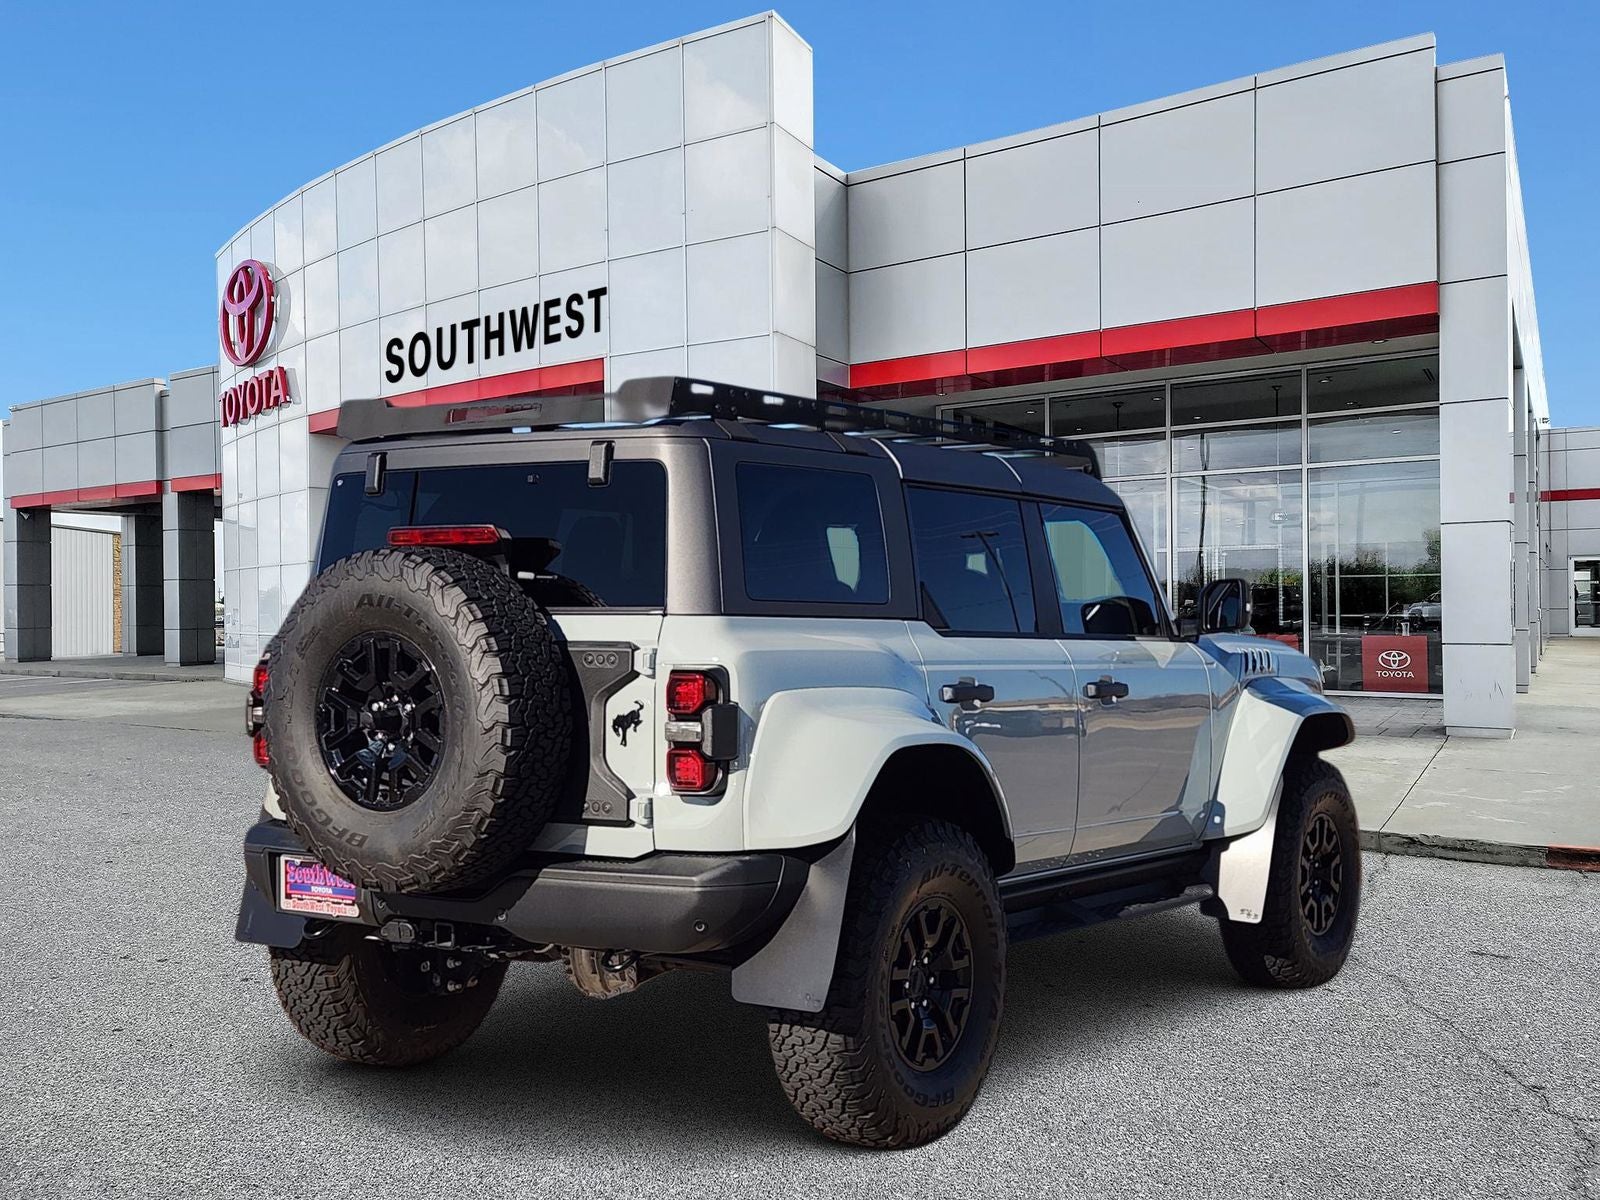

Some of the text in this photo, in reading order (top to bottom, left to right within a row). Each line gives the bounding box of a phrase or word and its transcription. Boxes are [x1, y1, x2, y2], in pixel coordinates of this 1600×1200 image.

[385, 286, 608, 384] SOUTHWEST
[218, 366, 291, 428] TOYOTA
[1376, 670, 1415, 678] TOYOTA
[311, 885, 333, 894] TOYOTA
